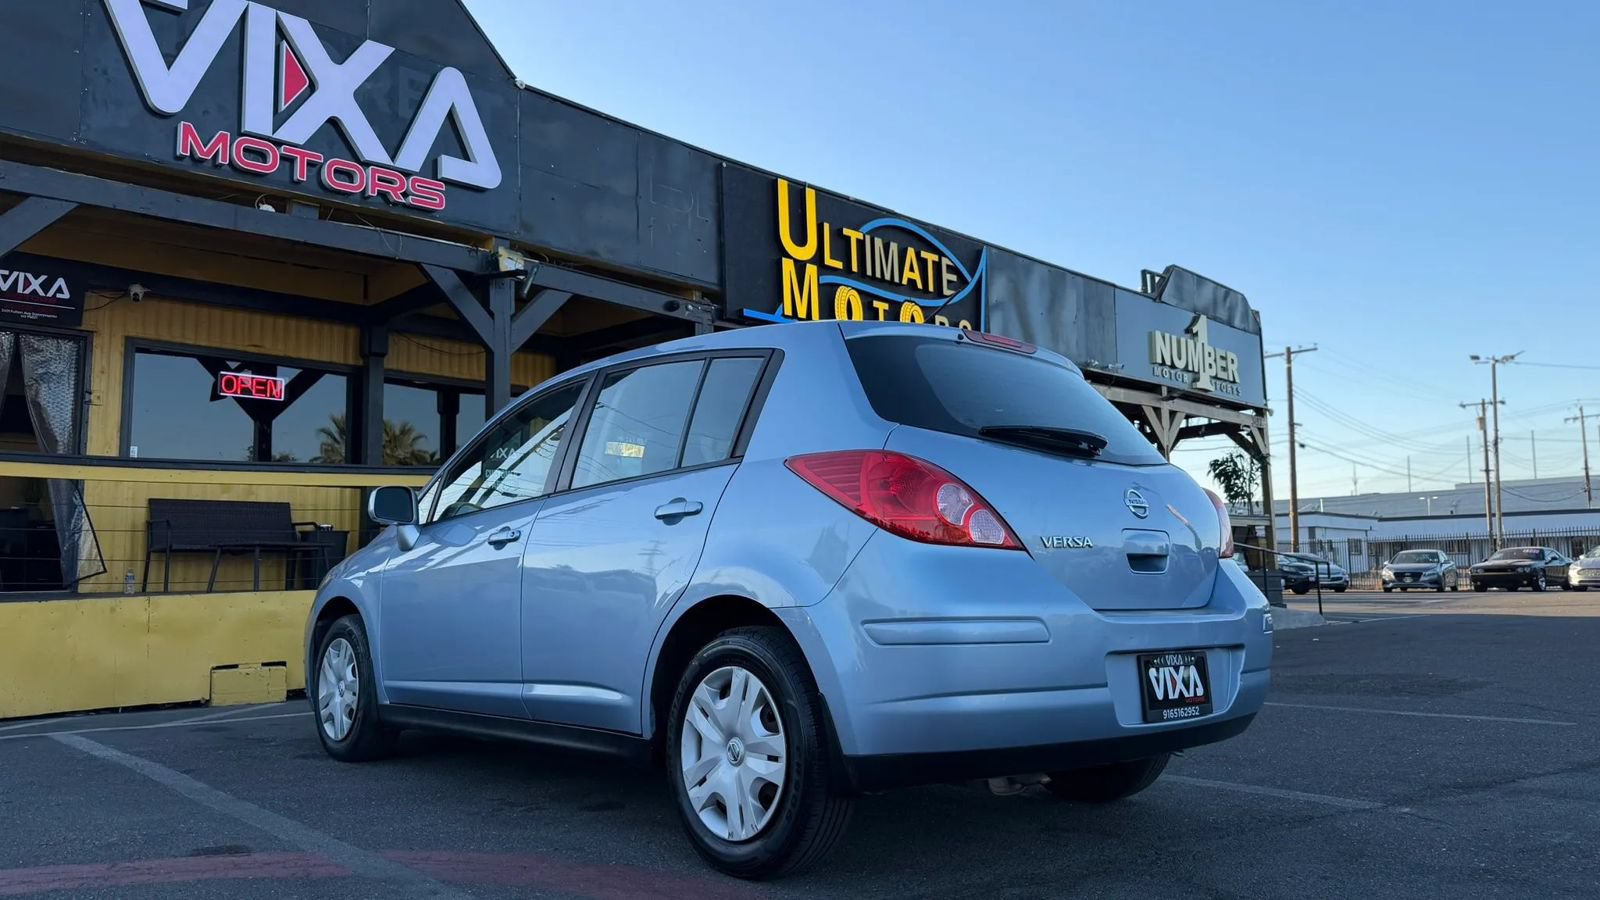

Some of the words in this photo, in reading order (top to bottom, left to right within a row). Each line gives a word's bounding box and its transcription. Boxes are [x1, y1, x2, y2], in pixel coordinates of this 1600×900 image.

[105, 0, 502, 190] VIXA
[177, 121, 446, 210] MOTORS
[777, 178, 957, 297] ULTIMATE
[0, 270, 71, 299] VIXA
[1149, 330, 1241, 384] NUMBER
[221, 375, 282, 398] OPEN
[1153, 366, 1190, 384] MOTOR
[1040, 536, 1093, 548] VERSA
[1165, 654, 1184, 666] VIXA
[1149, 665, 1204, 700] VIXA
[1162, 706, 1200, 719] 9165162952
